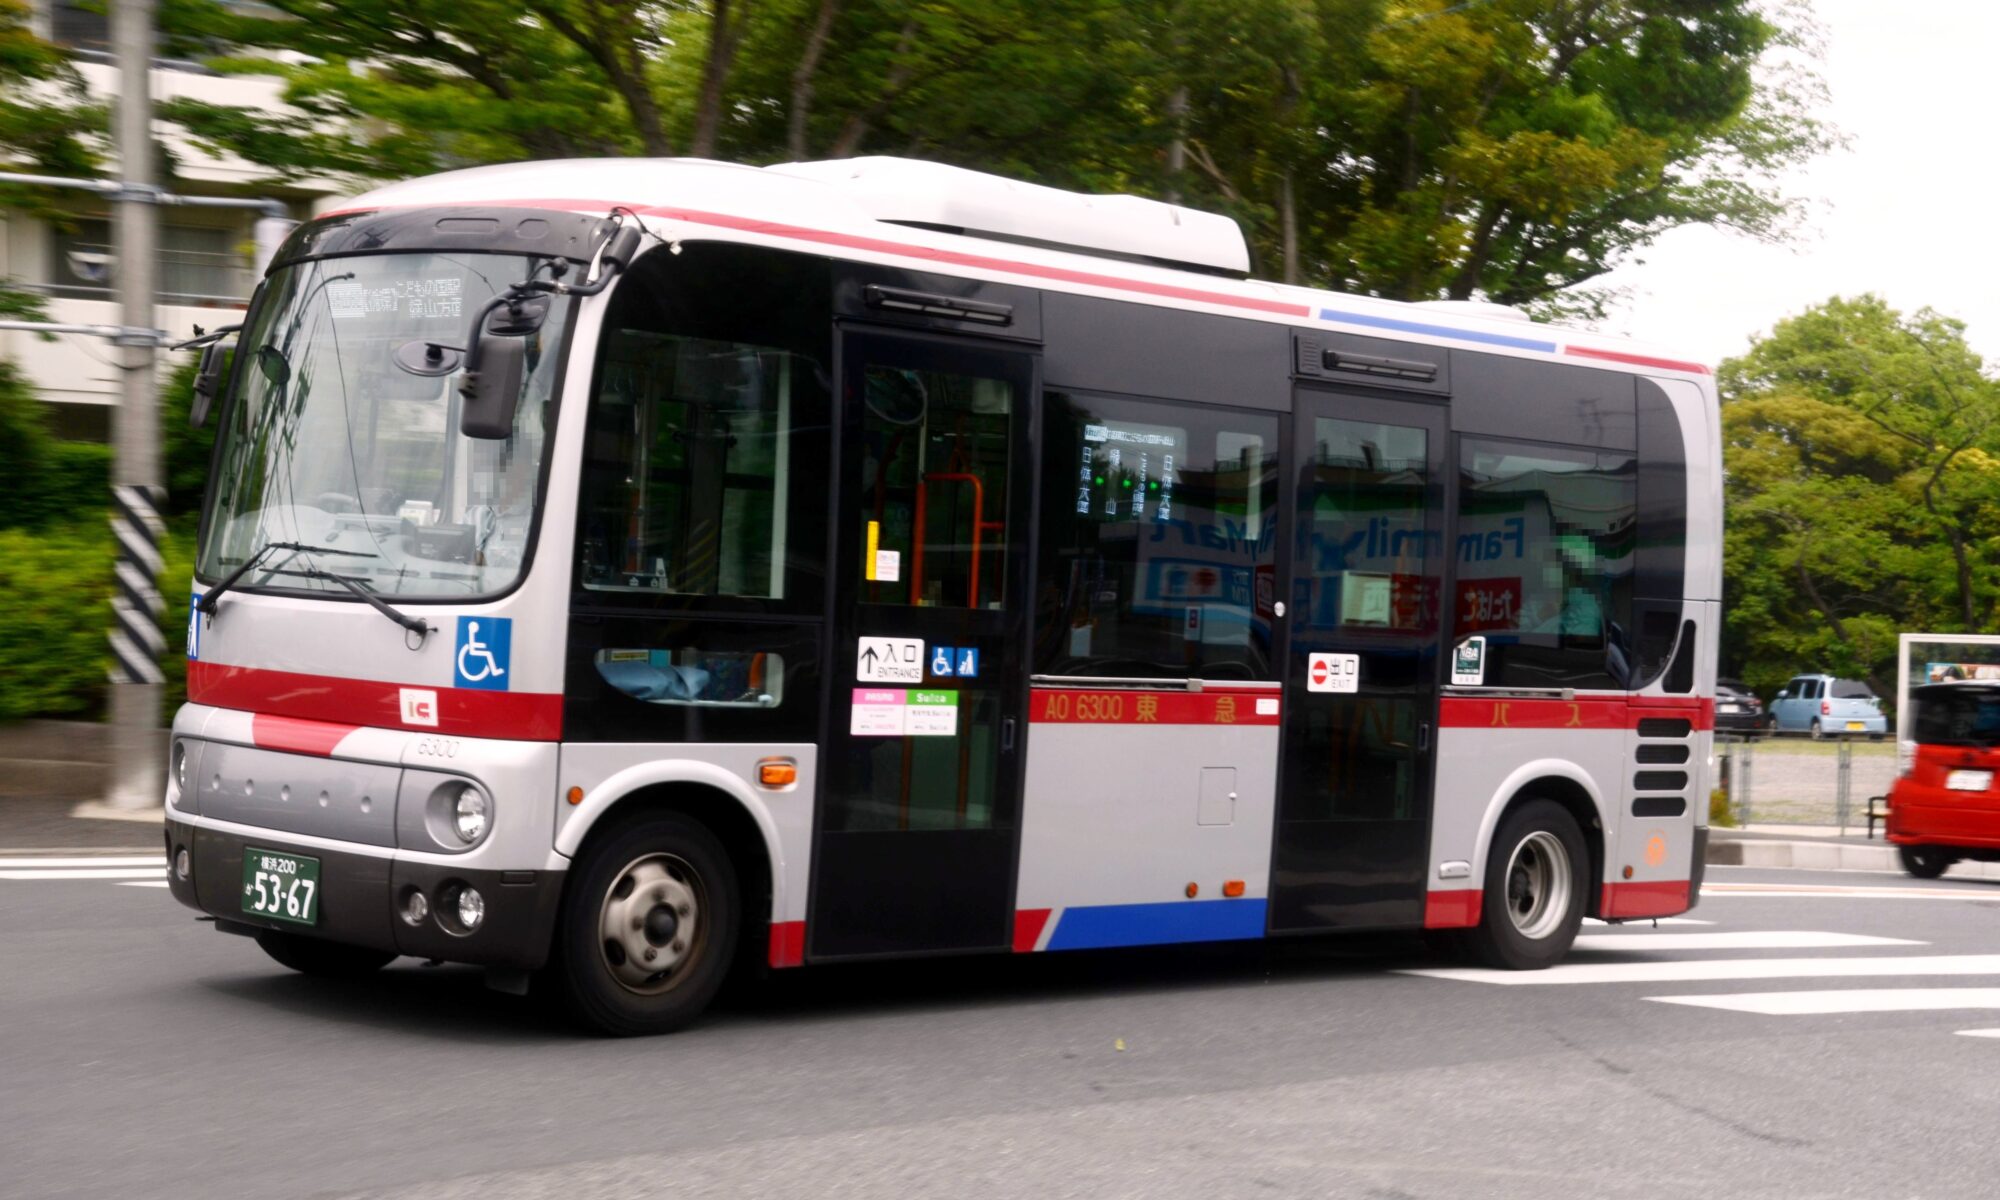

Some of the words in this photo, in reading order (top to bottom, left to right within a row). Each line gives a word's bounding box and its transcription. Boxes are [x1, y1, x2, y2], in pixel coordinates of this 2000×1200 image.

[883, 643, 917, 663] 入口
[877, 666, 921, 679] ENTRANCE
[1330, 657, 1355, 675] 出口
[916, 693, 947, 703] Suica
[1076, 694, 1123, 720] 6300
[418, 737, 460, 759] 6300
[254, 871, 315, 919] 53-67
